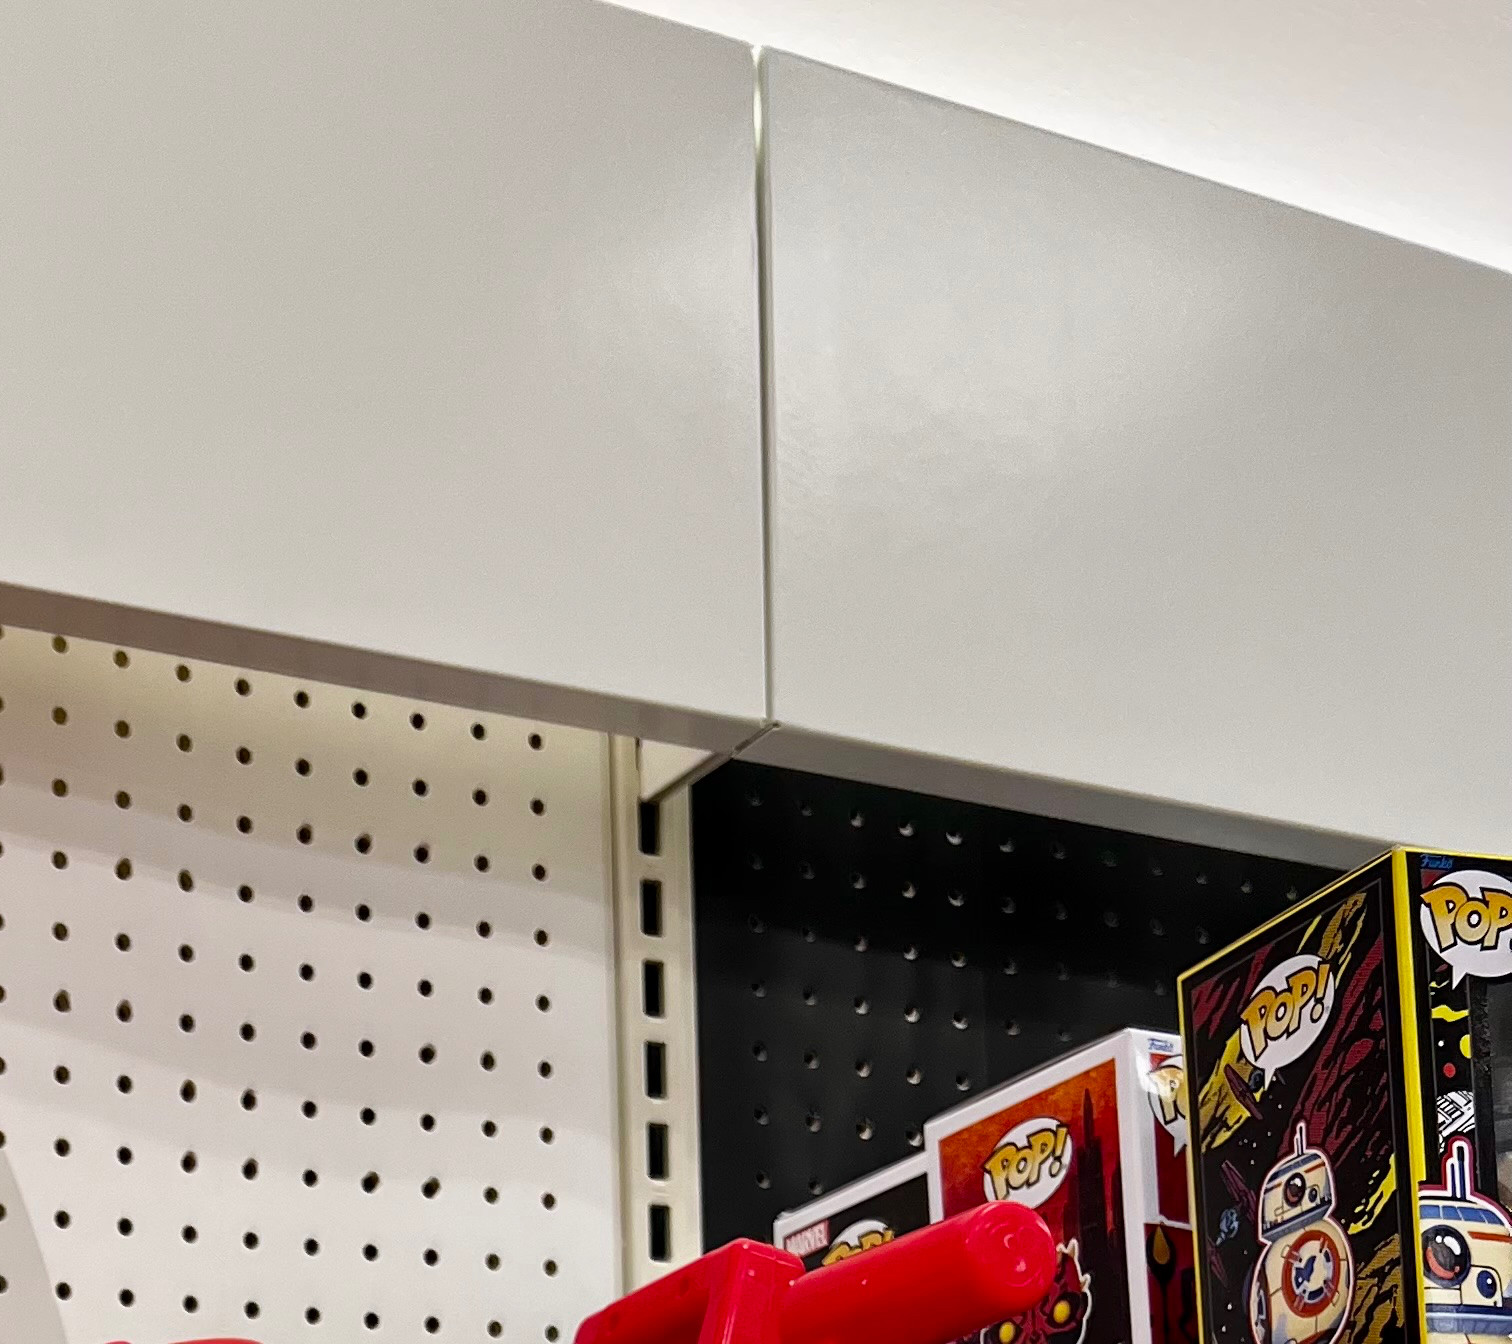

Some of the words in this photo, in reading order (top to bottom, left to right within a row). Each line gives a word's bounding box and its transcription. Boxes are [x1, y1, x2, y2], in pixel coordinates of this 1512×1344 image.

[1419, 881, 1512, 954] POP
[1241, 962, 1331, 1060] POP!
[981, 1122, 1072, 1204] POP!
